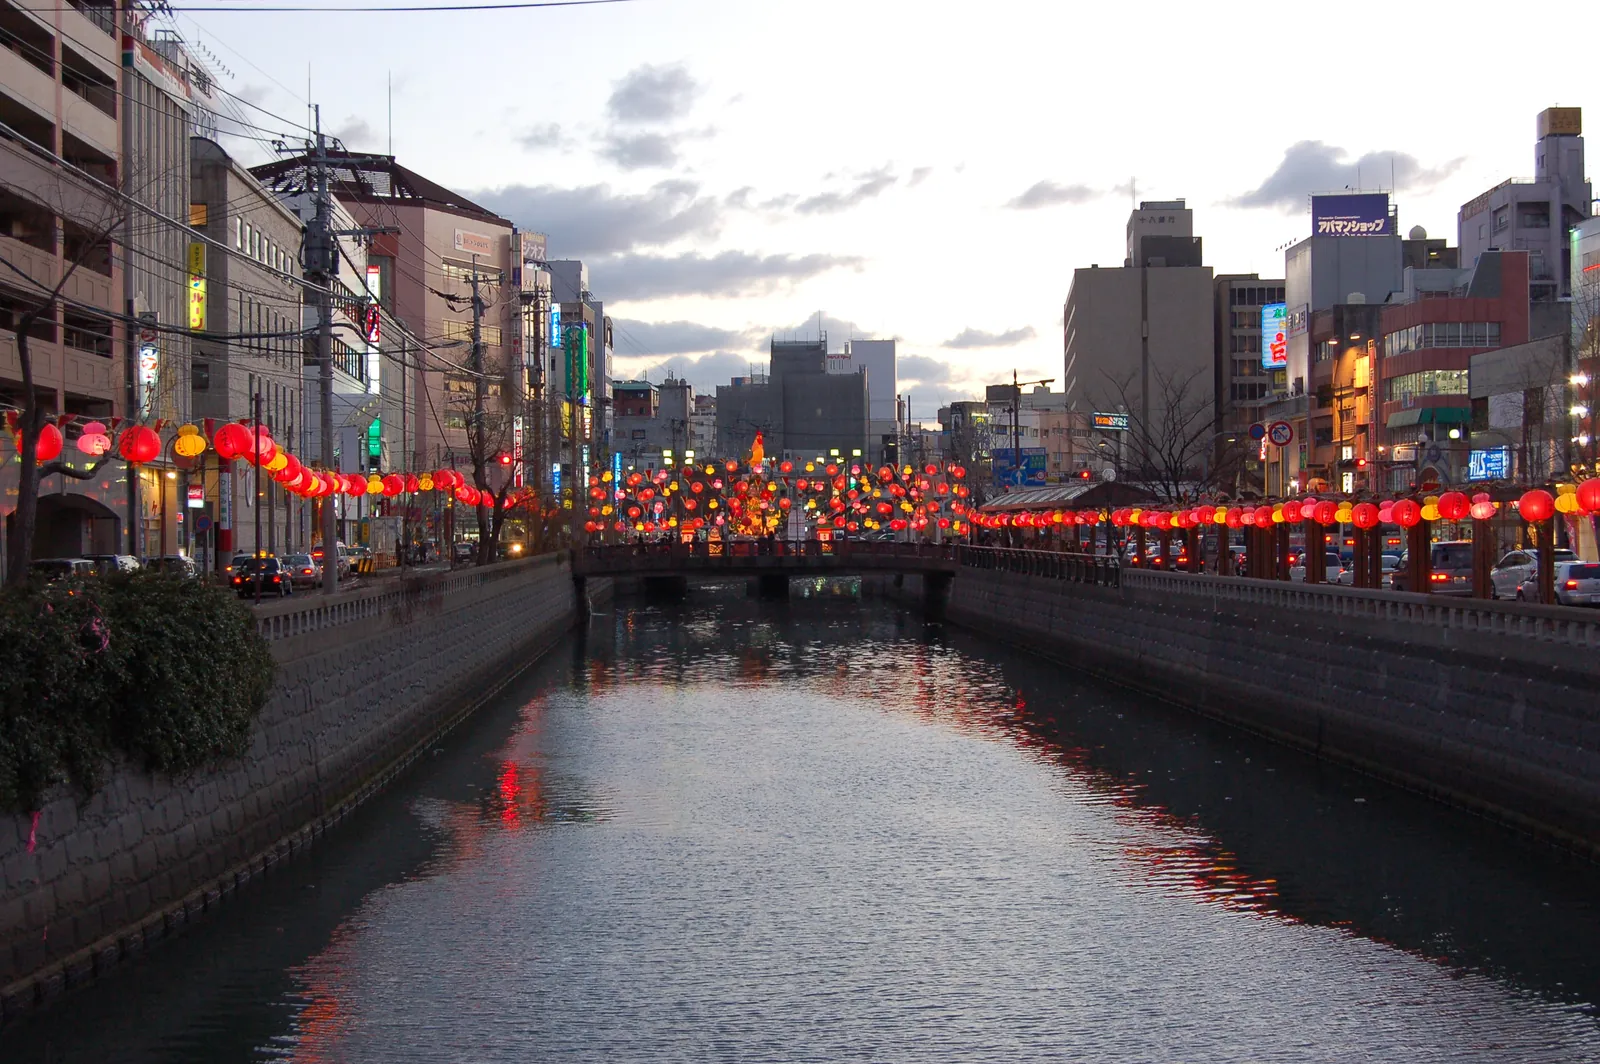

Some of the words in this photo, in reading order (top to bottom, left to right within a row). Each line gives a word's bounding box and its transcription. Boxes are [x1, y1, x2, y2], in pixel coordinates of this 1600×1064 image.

[1318, 219, 1384, 233] アパマンショップ
[523, 241, 546, 261] ジオス
